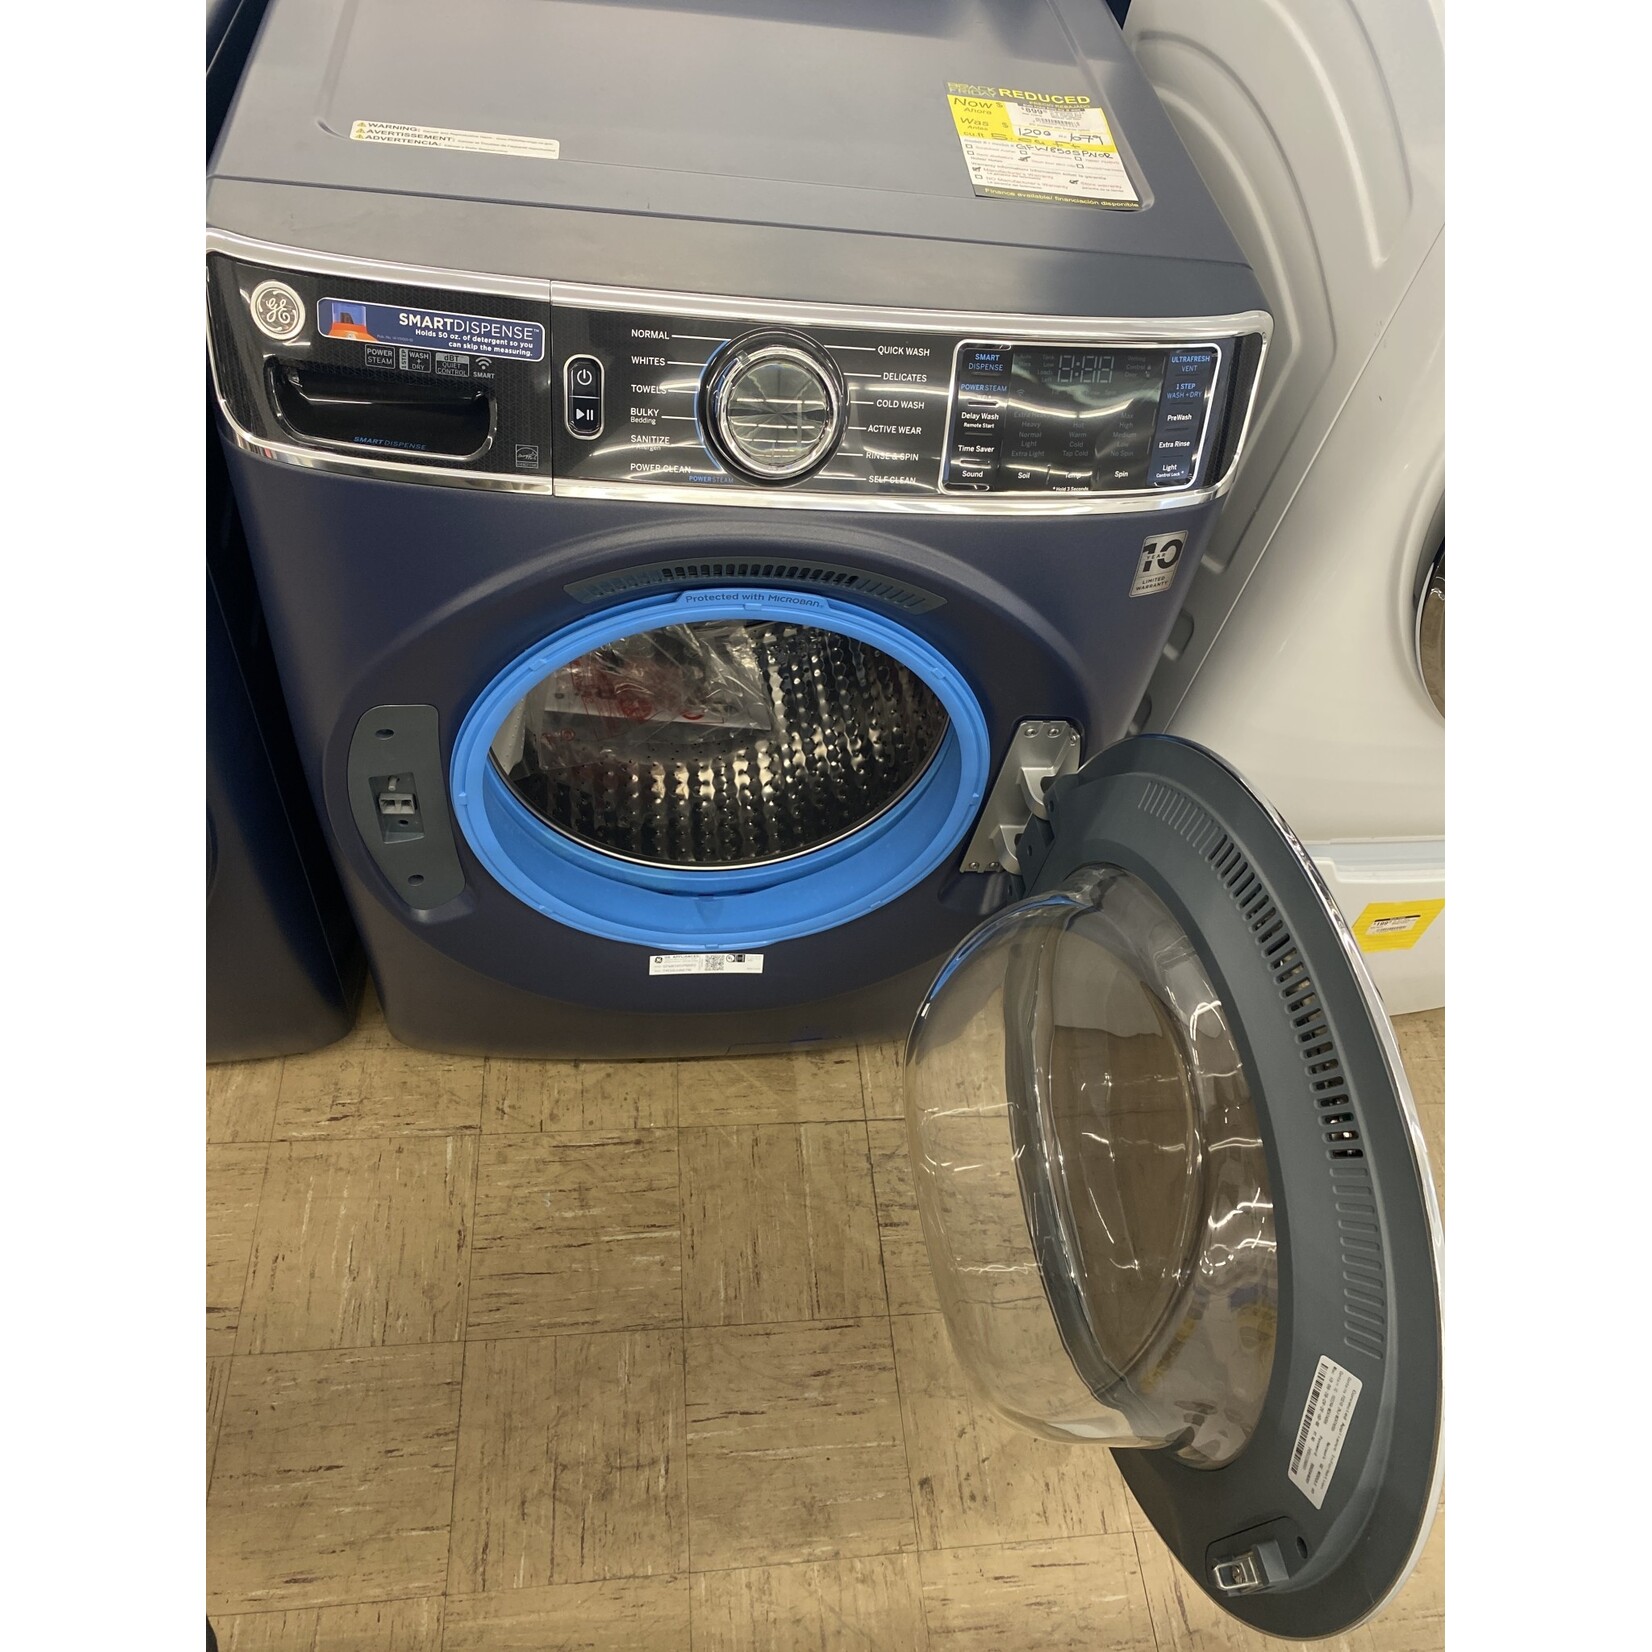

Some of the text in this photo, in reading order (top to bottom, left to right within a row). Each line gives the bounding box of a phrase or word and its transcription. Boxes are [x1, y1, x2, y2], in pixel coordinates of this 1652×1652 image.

[998, 88, 1090, 104] REDUCED
[954, 97, 992, 109] Now
[964, 107, 992, 115] Ahora
[960, 116, 989, 127] Was
[368, 122, 421, 132] WARNING:
[366, 128, 456, 142] AVERTISSEMENT:
[365, 135, 442, 146] ADVERTENCIA:
[984, 188, 1016, 196] Finance
[415, 328, 437, 338] Holds
[462, 332, 471, 341] of
[472, 334, 508, 347] detergent
[520, 341, 534, 350] you
[631, 329, 670, 340] NORMAL
[367, 348, 393, 357] POWER
[463, 342, 478, 351] skip
[480, 344, 492, 352] the
[494, 346, 533, 358] measuring.
[878, 346, 930, 356] QUICK WASH
[368, 356, 393, 365] STEAM
[408, 352, 429, 360] WASH
[631, 356, 666, 366] WHITES
[1172, 355, 1210, 363] ULTRAFRESH
[438, 368, 466, 376] CONTROL
[968, 362, 1004, 372] DISPENSE
[883, 372, 927, 382] DELICATES
[630, 384, 667, 394] TOWELS
[876, 400, 925, 410] COLD WASH
[630, 408, 660, 417] BULKY
[962, 412, 980, 420] Delay
[630, 416, 656, 426] Bedding
[868, 425, 922, 434] ACTIVE WEAR
[630, 434, 670, 445] SANITIZE
[866, 452, 890, 460] RINSE
[900, 452, 919, 460] SPIN
[630, 463, 692, 474] POWER CLEAN
[1114, 470, 1129, 479] Spin
[688, 476, 734, 484] POWERSTEAM
[868, 476, 890, 484] SELF
[1142, 539, 1184, 572] 10
[1142, 576, 1166, 584] LIMITED
[1136, 581, 1168, 590] WARRANTY
[686, 593, 738, 603] Protected
